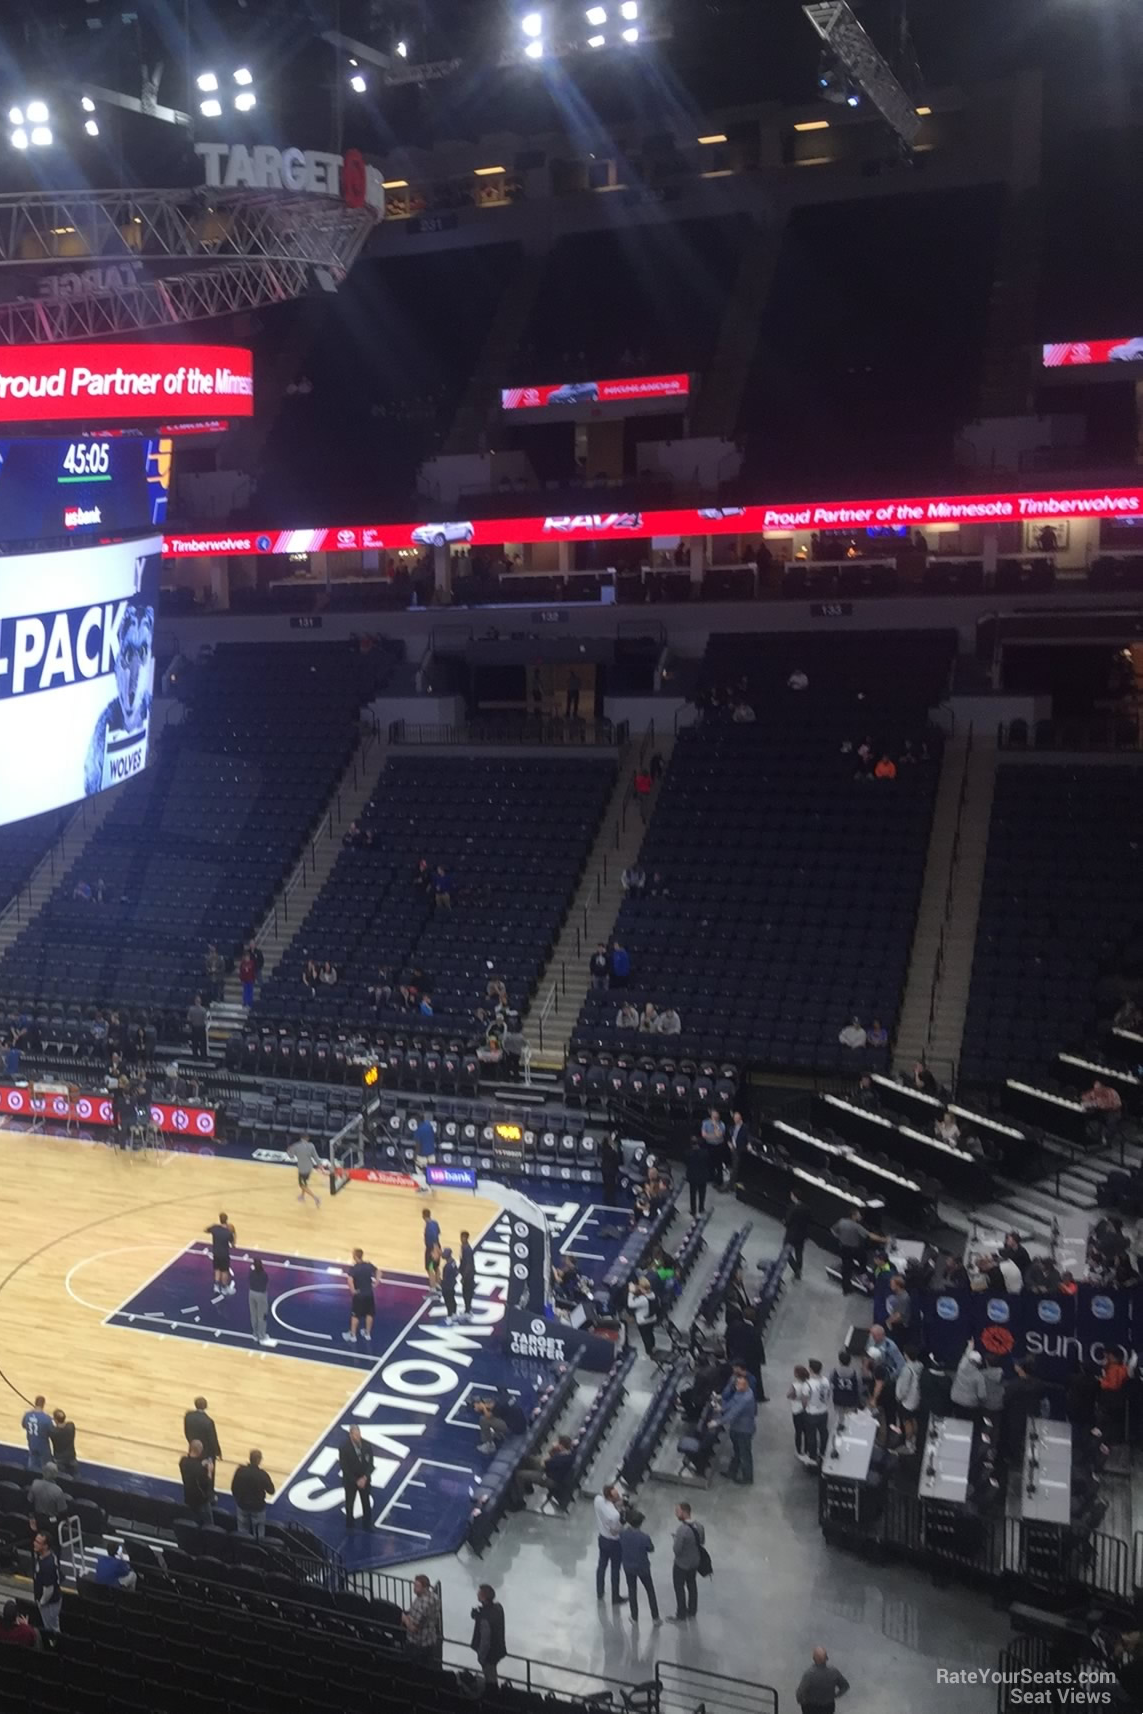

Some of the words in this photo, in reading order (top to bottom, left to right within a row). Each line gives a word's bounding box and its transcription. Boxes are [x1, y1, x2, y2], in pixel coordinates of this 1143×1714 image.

[194, 142, 343, 196] TARGET
[71, 367, 161, 396] Partner
[163, 367, 187, 395] of
[187, 367, 214, 394] the
[214, 368, 254, 396] Minnes
[63, 443, 110, 475] 45:05
[541, 511, 644, 533] RAV4
[763, 508, 811, 525] Proud
[813, 507, 874, 523] Partner
[875, 504, 896, 521] of
[896, 504, 924, 519] the
[927, 500, 1013, 518] Minnesota
[1017, 495, 1139, 514] Timberwolves
[171, 537, 251, 553] Timberwolves
[109, 747, 142, 780] WOLVES
[510, 1330, 565, 1351] TARGET
[510, 1341, 565, 1361] CENTER
[1025, 1330, 1083, 1363] sun
